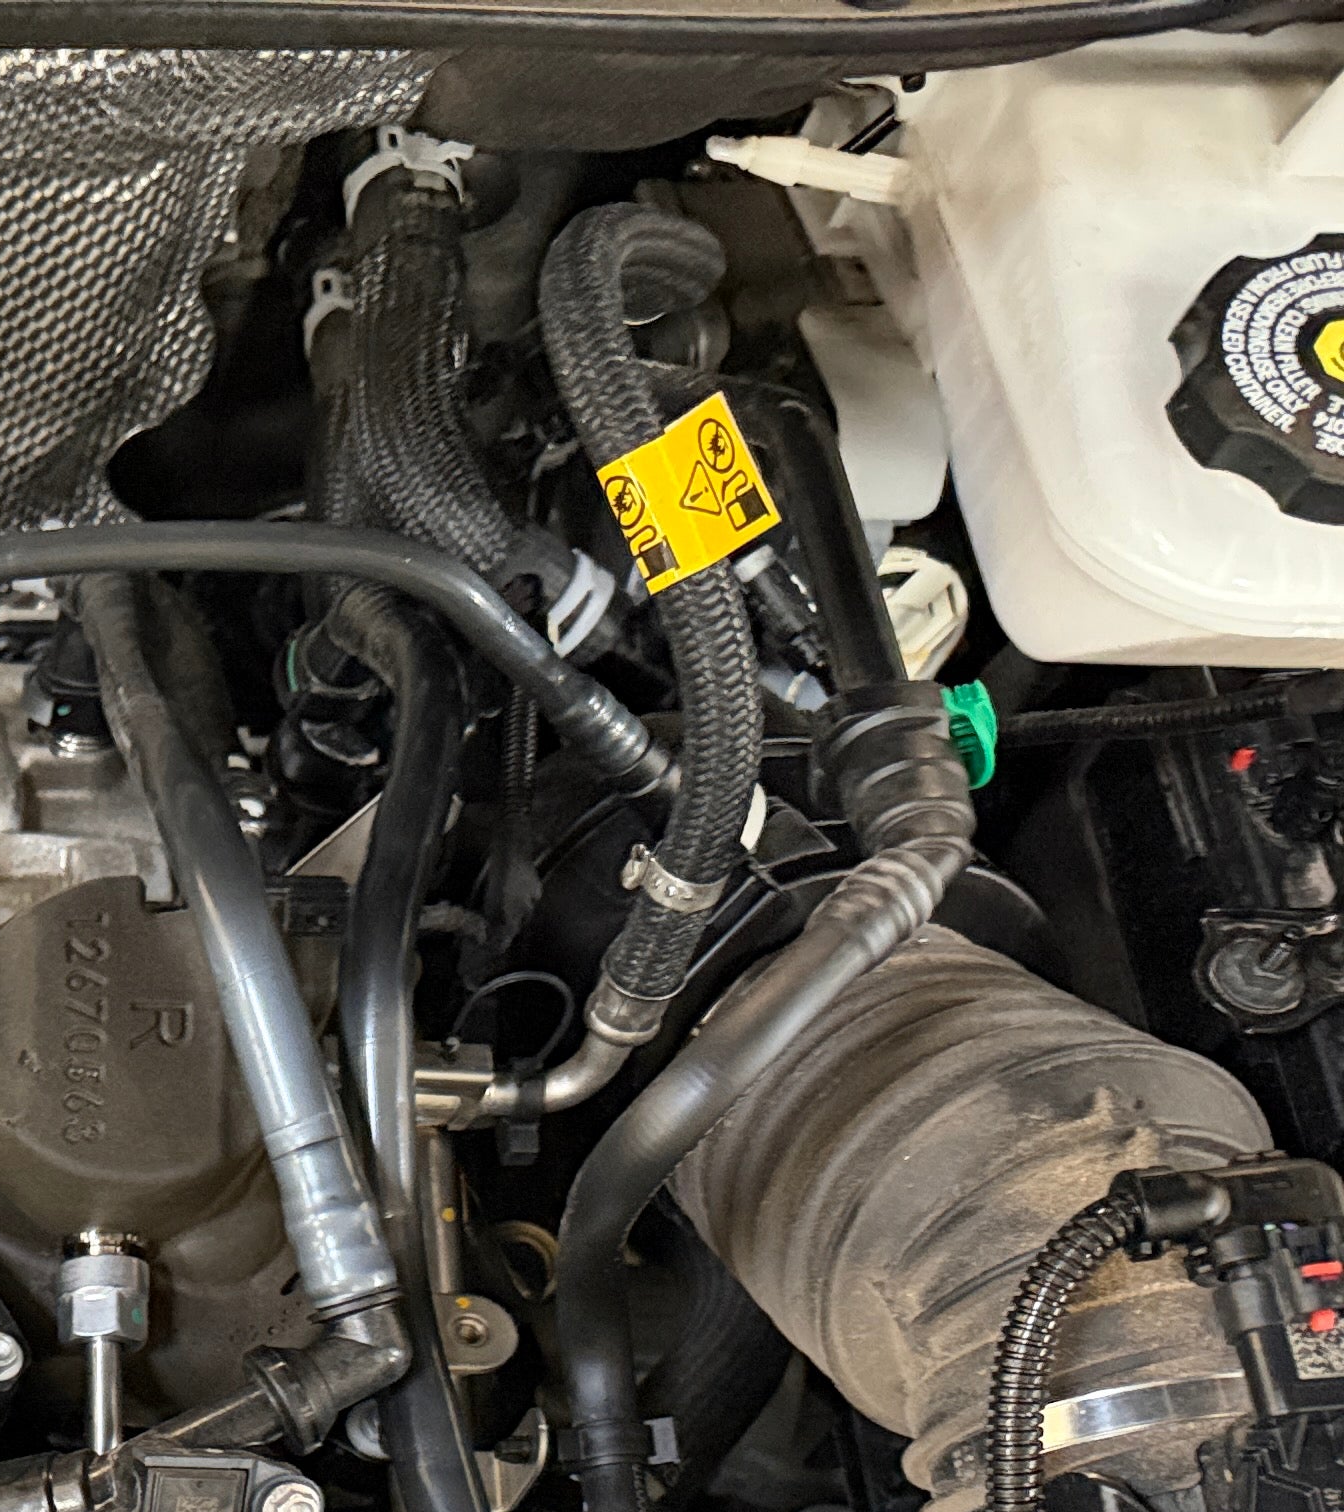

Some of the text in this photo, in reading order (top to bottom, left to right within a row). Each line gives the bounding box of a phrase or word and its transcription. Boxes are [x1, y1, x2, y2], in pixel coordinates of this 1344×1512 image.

[1221, 299, 1255, 354] SEALED
[1249, 352, 1281, 383] USE
[1265, 379, 1311, 414] ONLY
[128, 1001, 194, 1050] R
